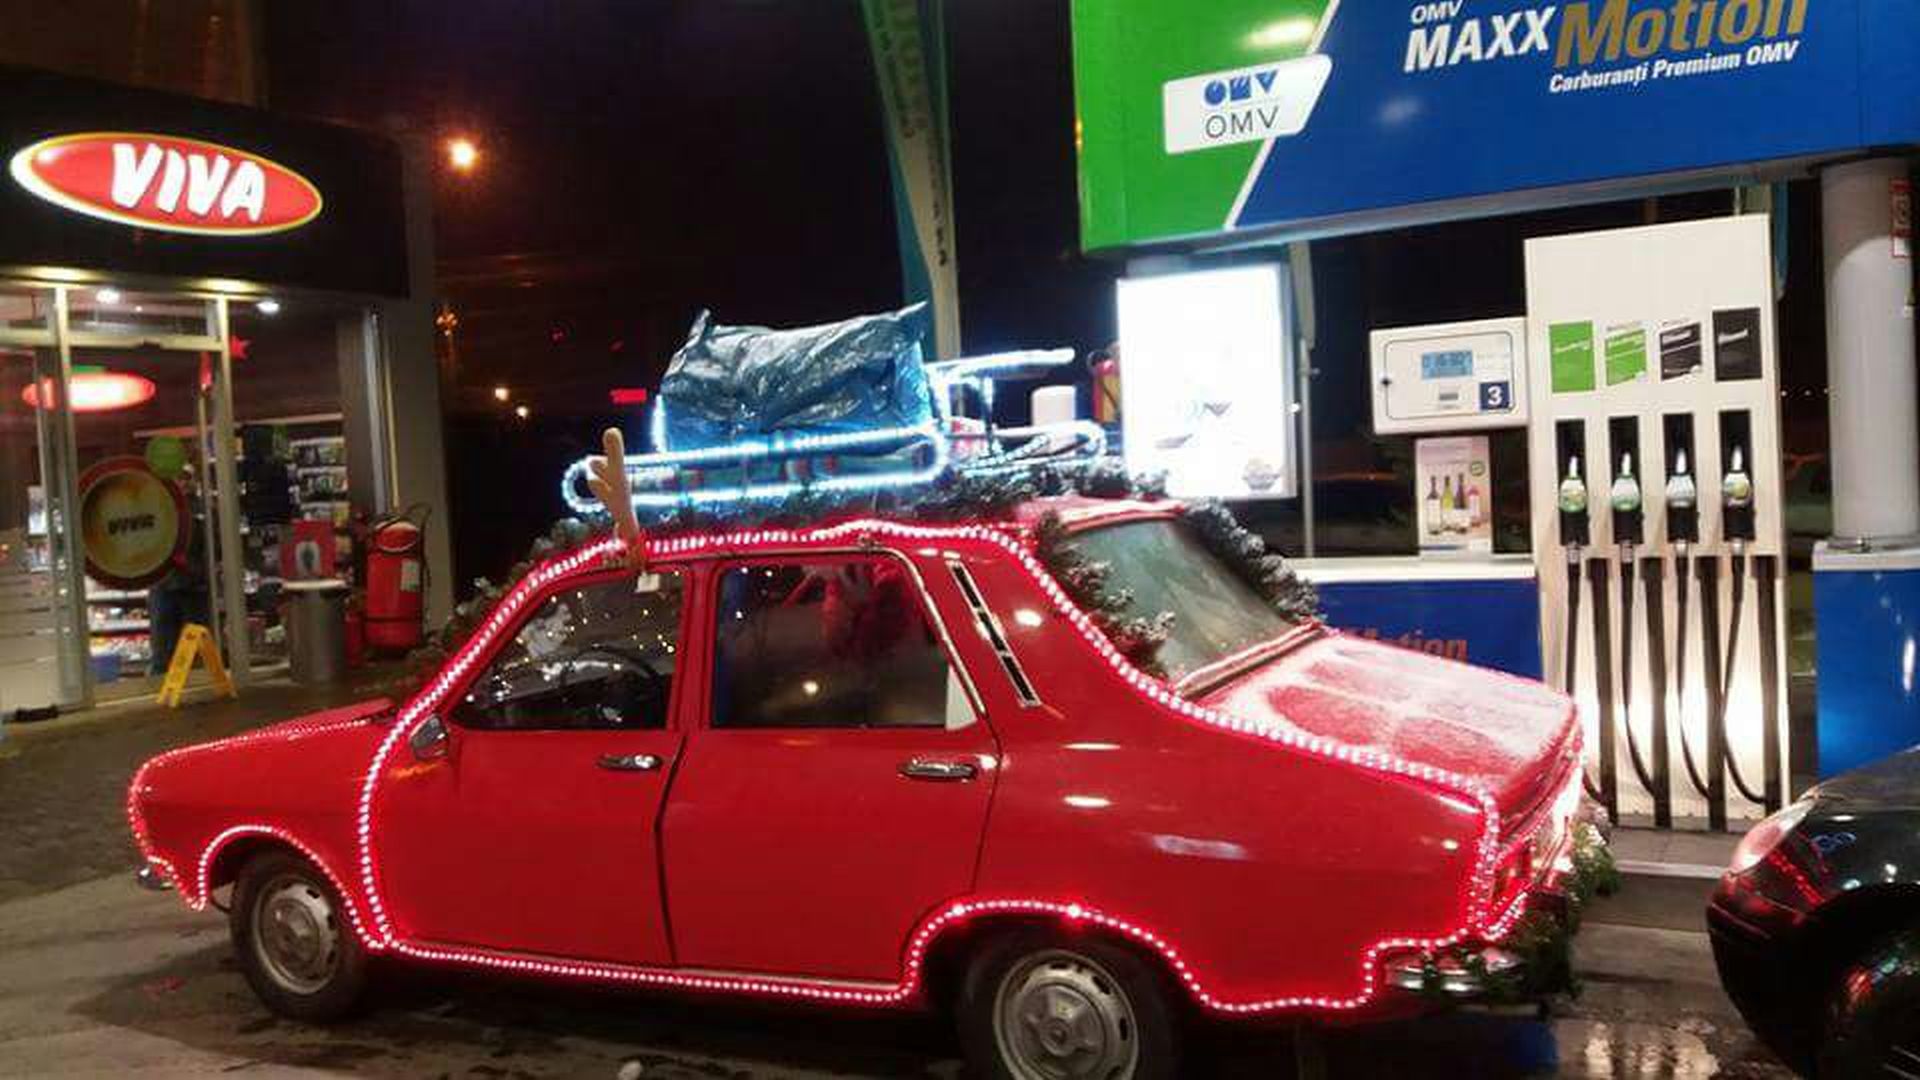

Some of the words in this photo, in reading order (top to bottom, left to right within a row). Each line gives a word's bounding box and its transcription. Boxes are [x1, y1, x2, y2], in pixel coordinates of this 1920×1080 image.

[1411, 0, 1463, 24] OMV
[1404, 6, 1556, 73] MAXX
[1553, 0, 1808, 68] Motion
[1651, 52, 1741, 79] Premium
[1746, 40, 1799, 66] OMV
[1205, 106, 1279, 138] OMV
[111, 143, 266, 222] VIVA
[1487, 386, 1503, 406] 3
